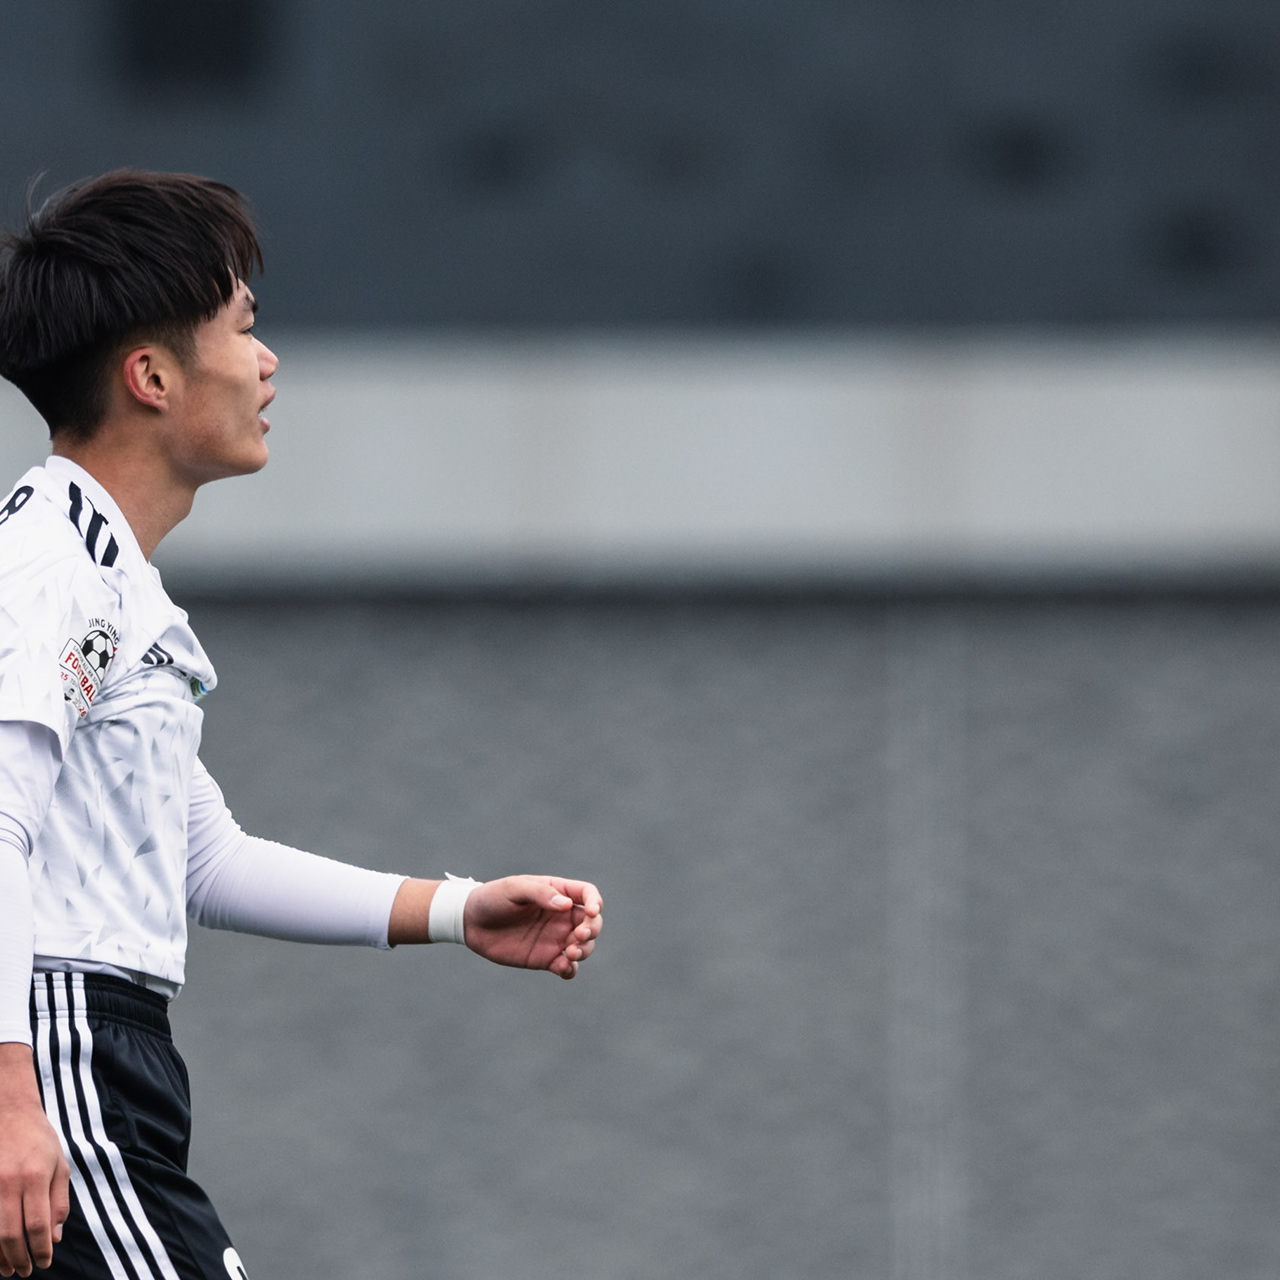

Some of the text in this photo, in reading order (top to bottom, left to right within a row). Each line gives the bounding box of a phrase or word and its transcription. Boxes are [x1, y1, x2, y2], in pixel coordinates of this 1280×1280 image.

[88, 617, 120, 646] JING YING
[64, 651, 98, 703] FOOTBAL
